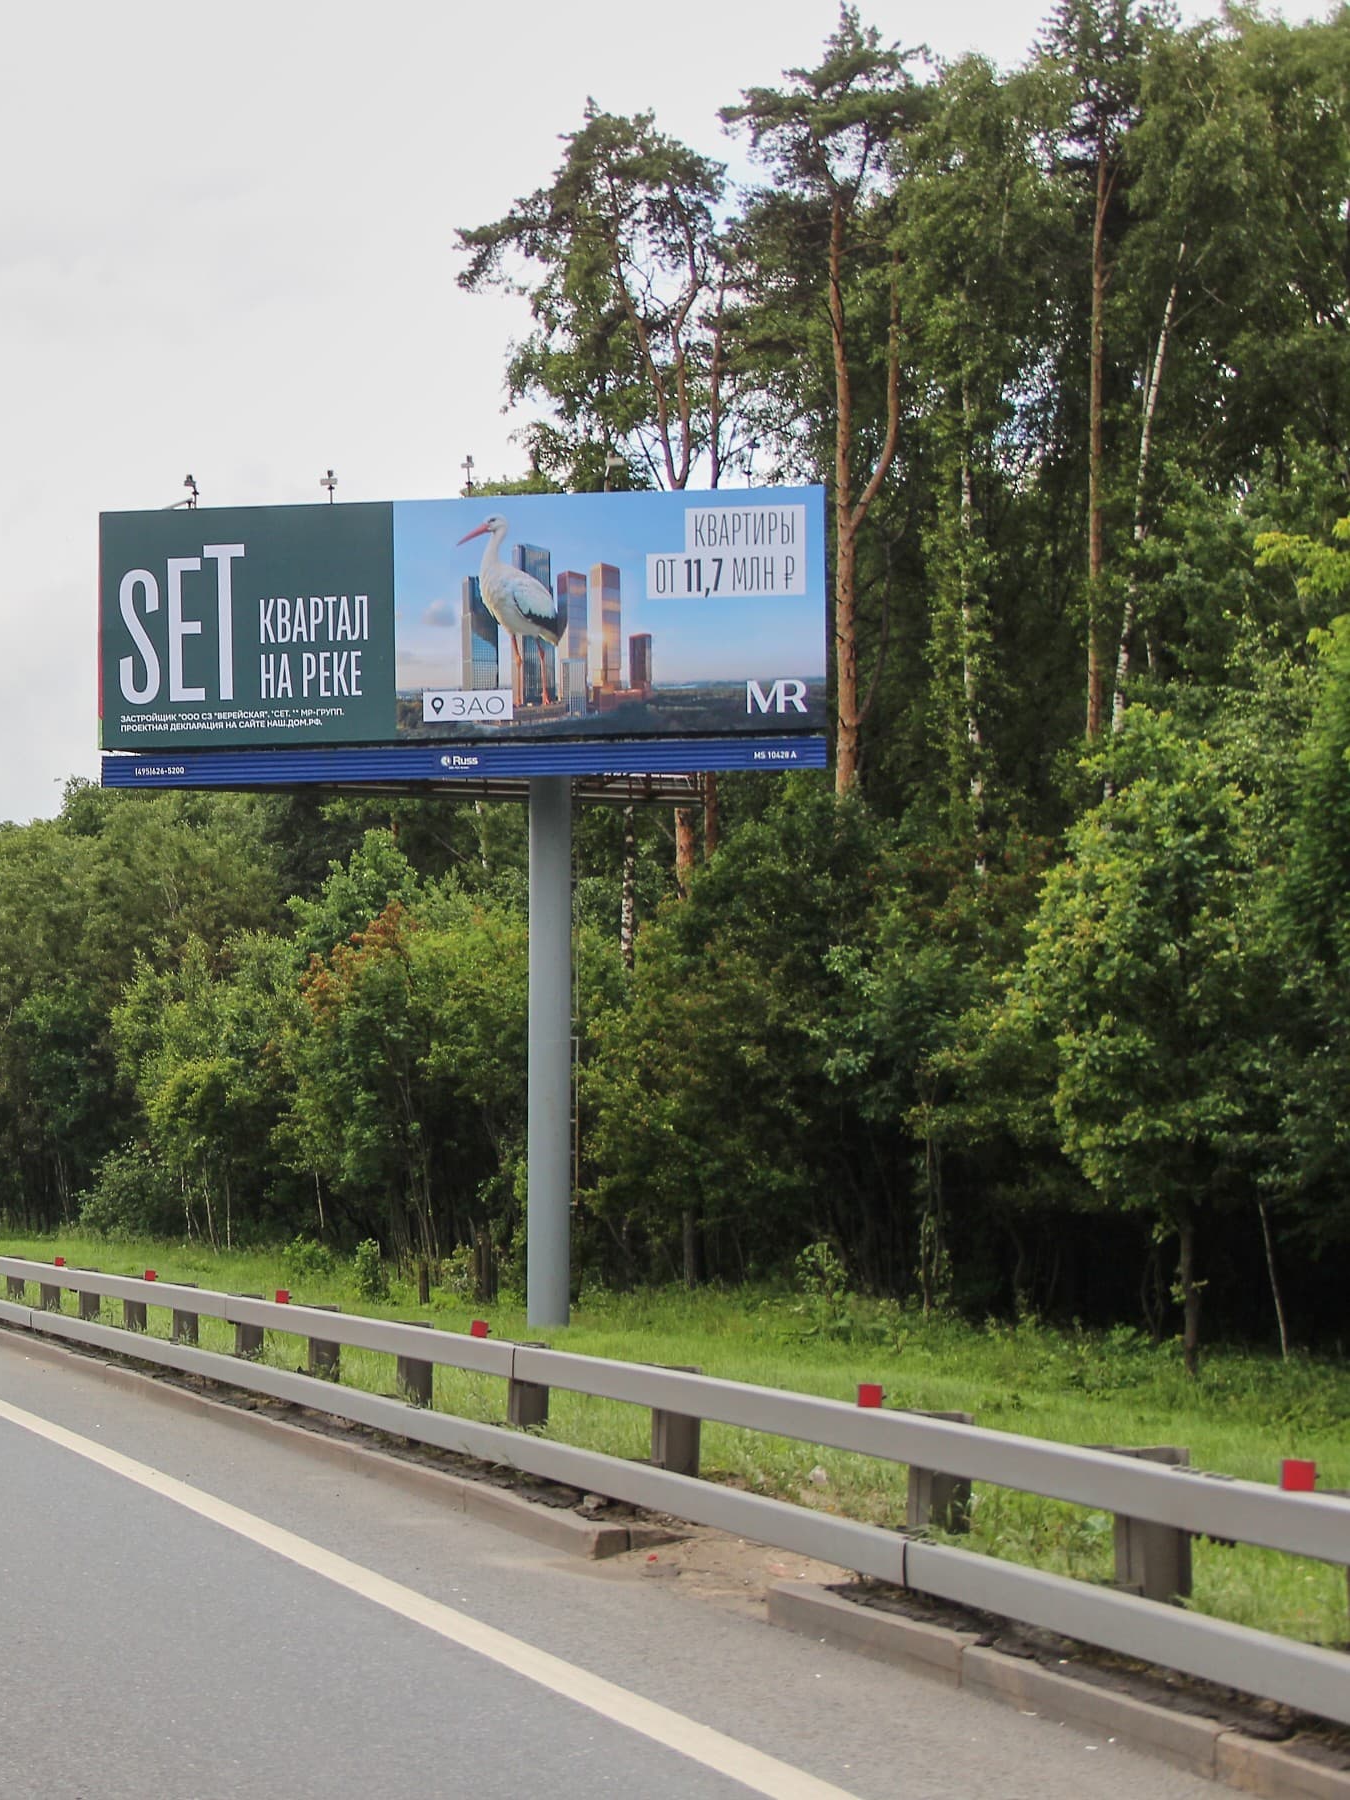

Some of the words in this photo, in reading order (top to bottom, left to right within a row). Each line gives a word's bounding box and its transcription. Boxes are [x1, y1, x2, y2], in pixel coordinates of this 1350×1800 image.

[694, 511, 795, 548] КВАРТИРЫ
[655, 558, 677, 594] ОТ
[683, 557, 723, 599] 11,7
[732, 555, 775, 591] МЛН
[119, 543, 247, 705] SET
[259, 594, 369, 644] КВАРТАЛ
[260, 652, 294, 700] НА
[302, 650, 363, 698] РЕКЕ
[451, 695, 505, 716] ЗАО
[746, 679, 808, 714] MR
[120, 712, 177, 724] ЗАСТРОЙЩИК
[120, 722, 169, 733] ПРОЕКТНАЯ
[169, 720, 225, 732] ДЕКЛАРАЦИЯ
[225, 720, 238, 729] НА
[238, 718, 266, 729] САЙТЕ
[452, 755, 479, 766] Russ
